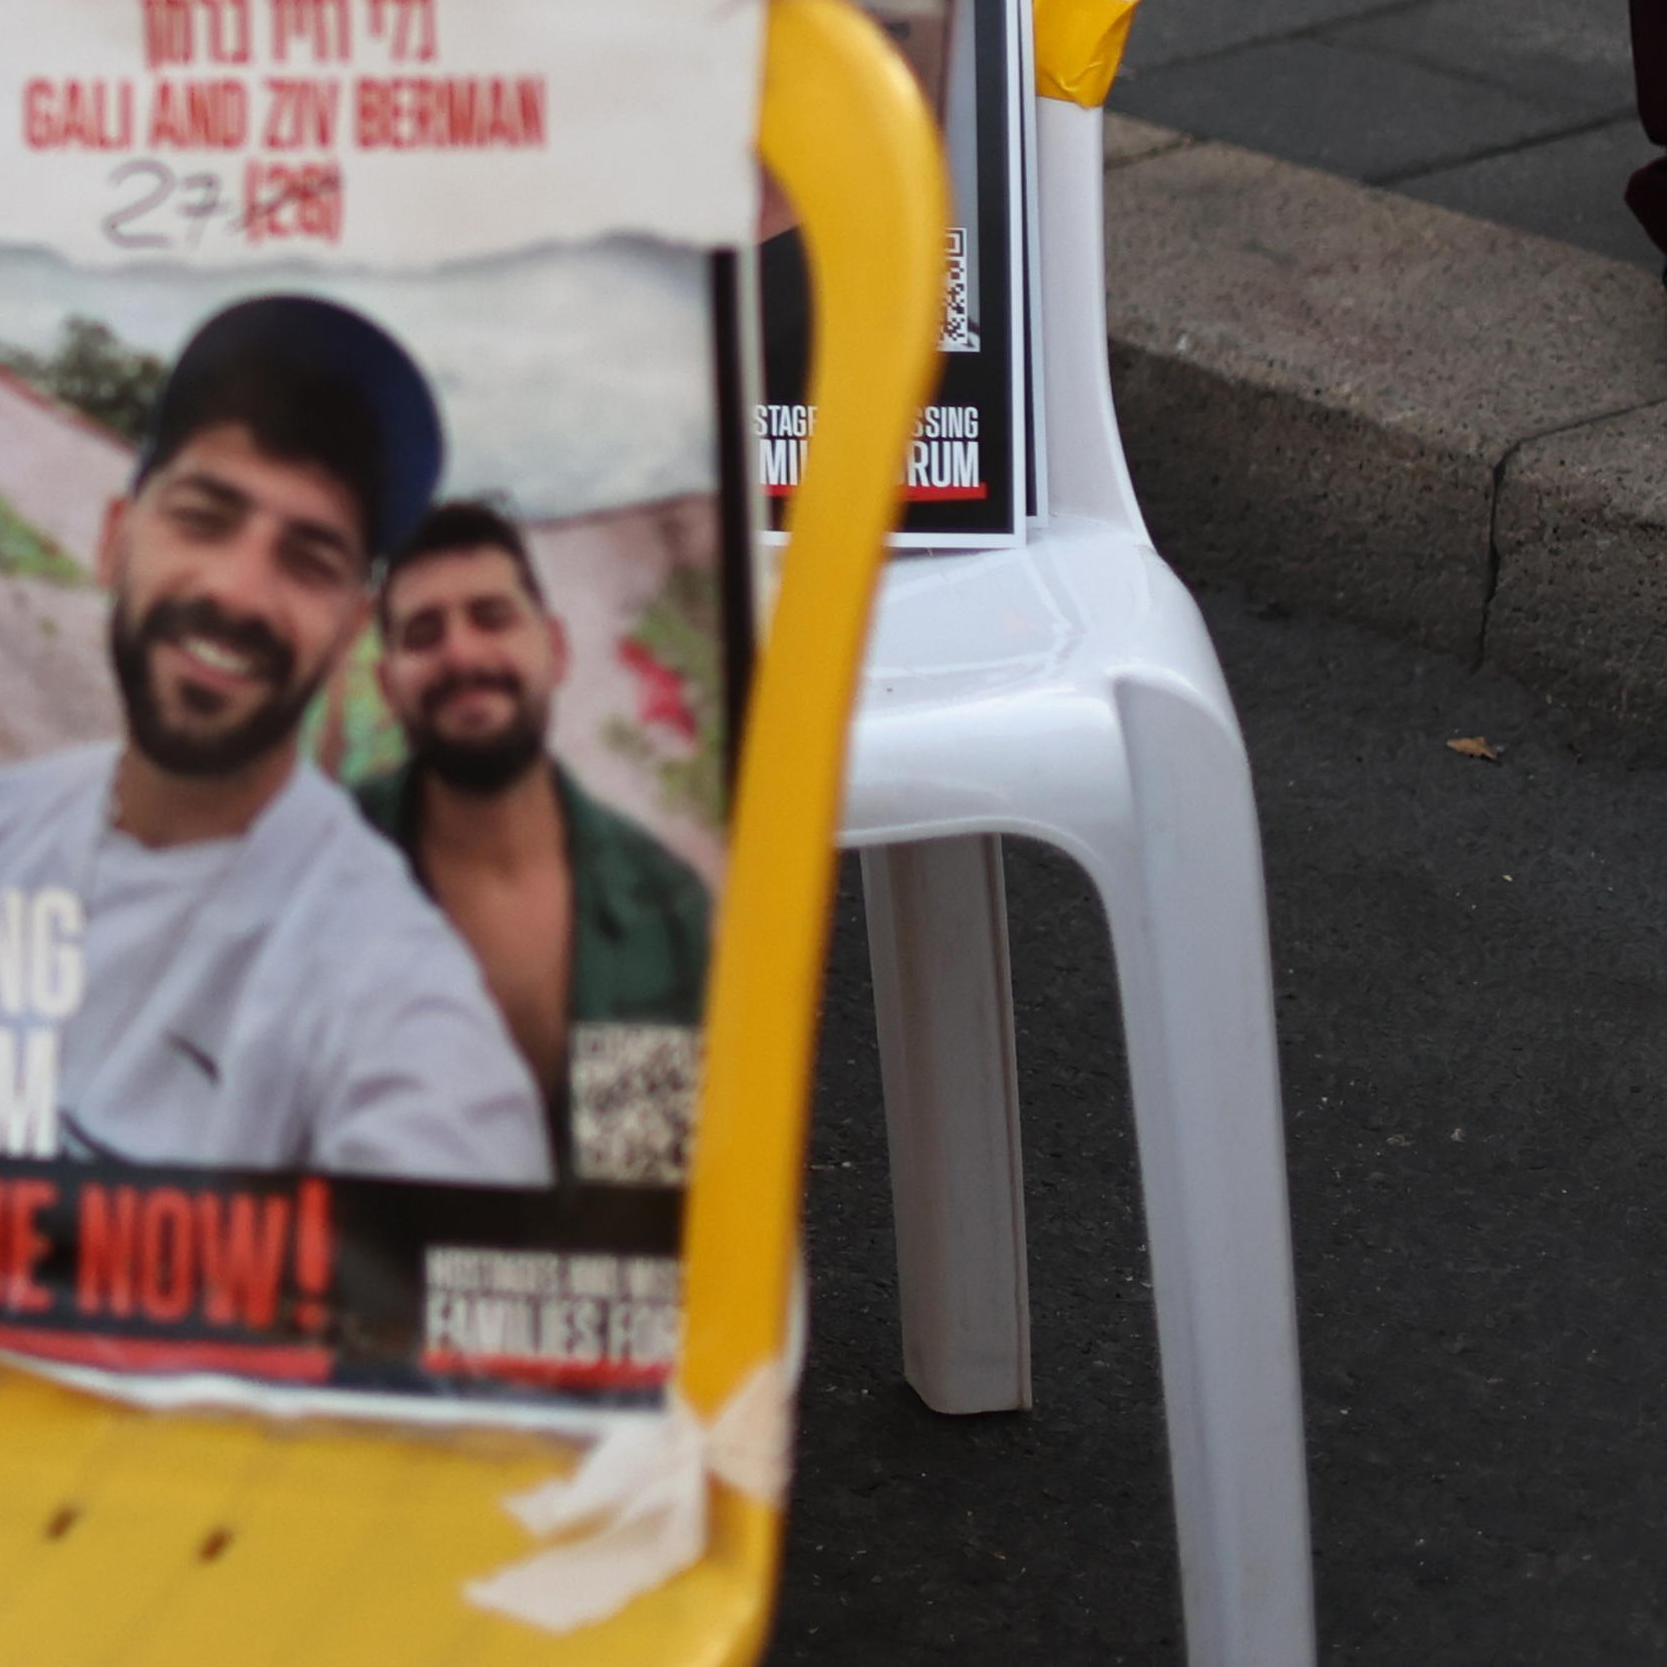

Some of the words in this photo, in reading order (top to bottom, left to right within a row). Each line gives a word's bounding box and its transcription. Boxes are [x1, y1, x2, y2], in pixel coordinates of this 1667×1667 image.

[24, 75, 135, 153] GALI
[147, 75, 251, 153] AND
[261, 75, 342, 153] ZIV
[354, 75, 549, 153] BERMAN
[77, 1176, 332, 1334] NOW!
